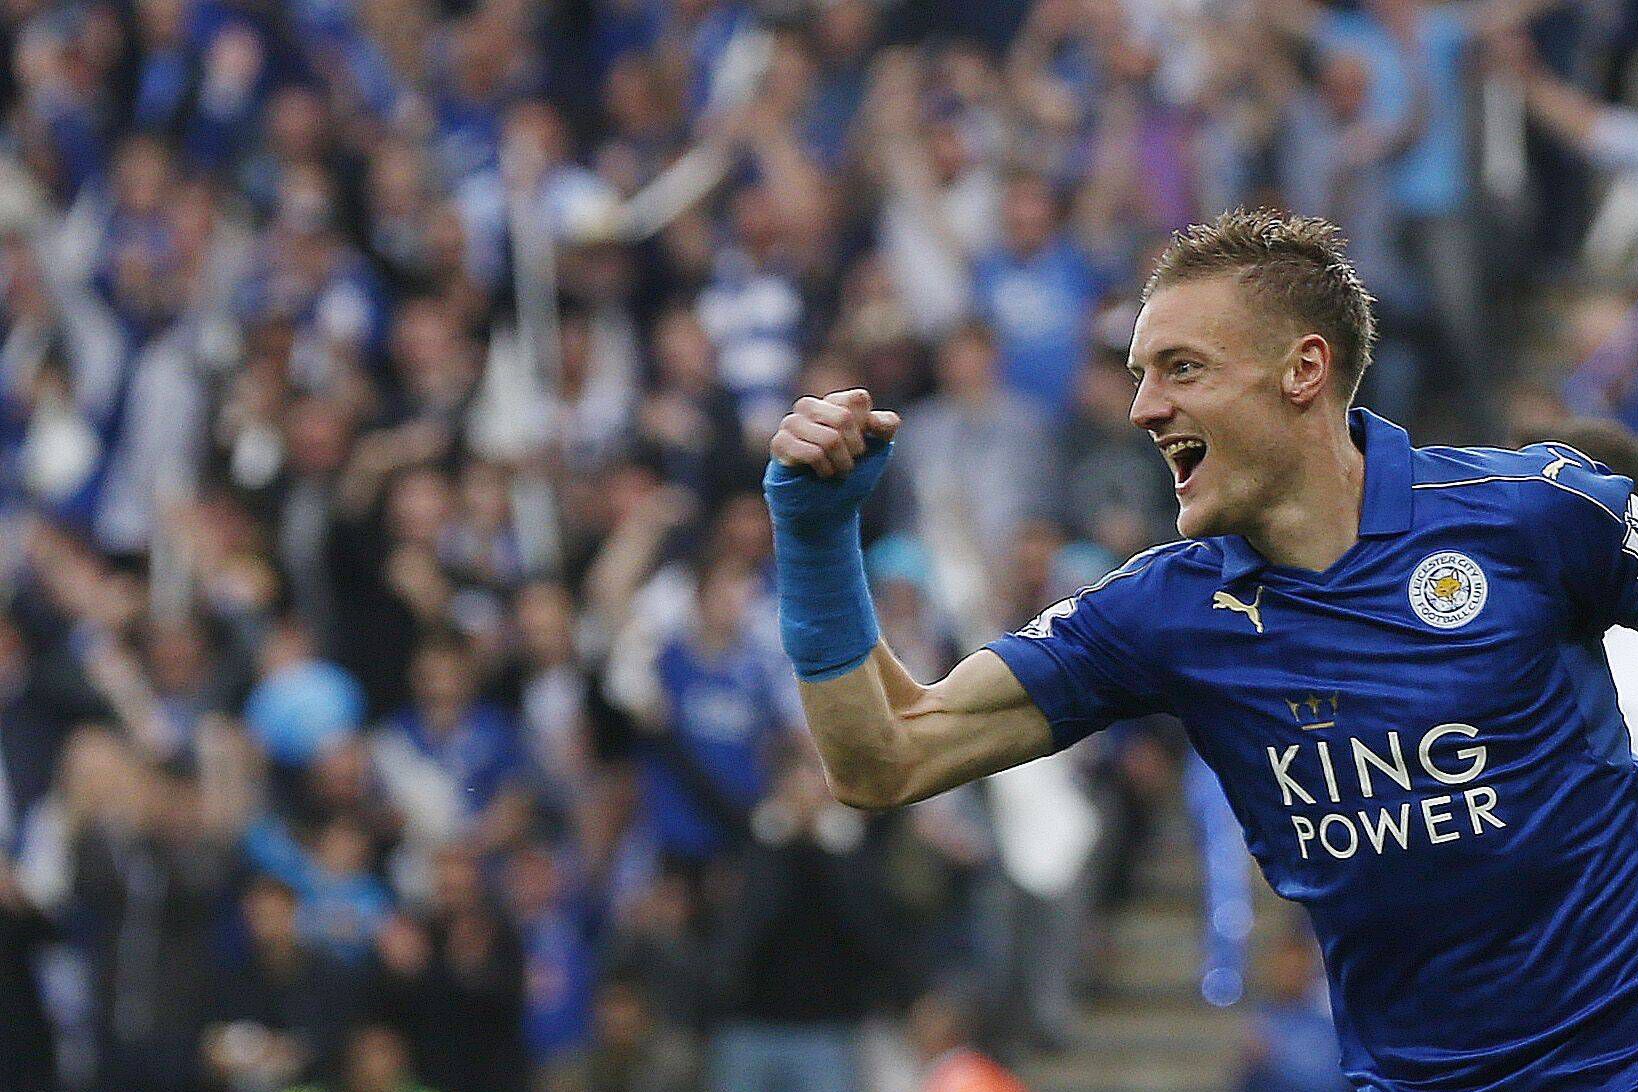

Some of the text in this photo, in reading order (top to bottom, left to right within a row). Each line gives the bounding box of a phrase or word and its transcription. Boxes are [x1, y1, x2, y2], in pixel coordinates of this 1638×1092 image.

[1457, 559, 1480, 577] CITY
[1417, 602, 1469, 623] FOOTBALL
[1267, 723, 1487, 806] KING
[1291, 786, 1507, 860] POWER
